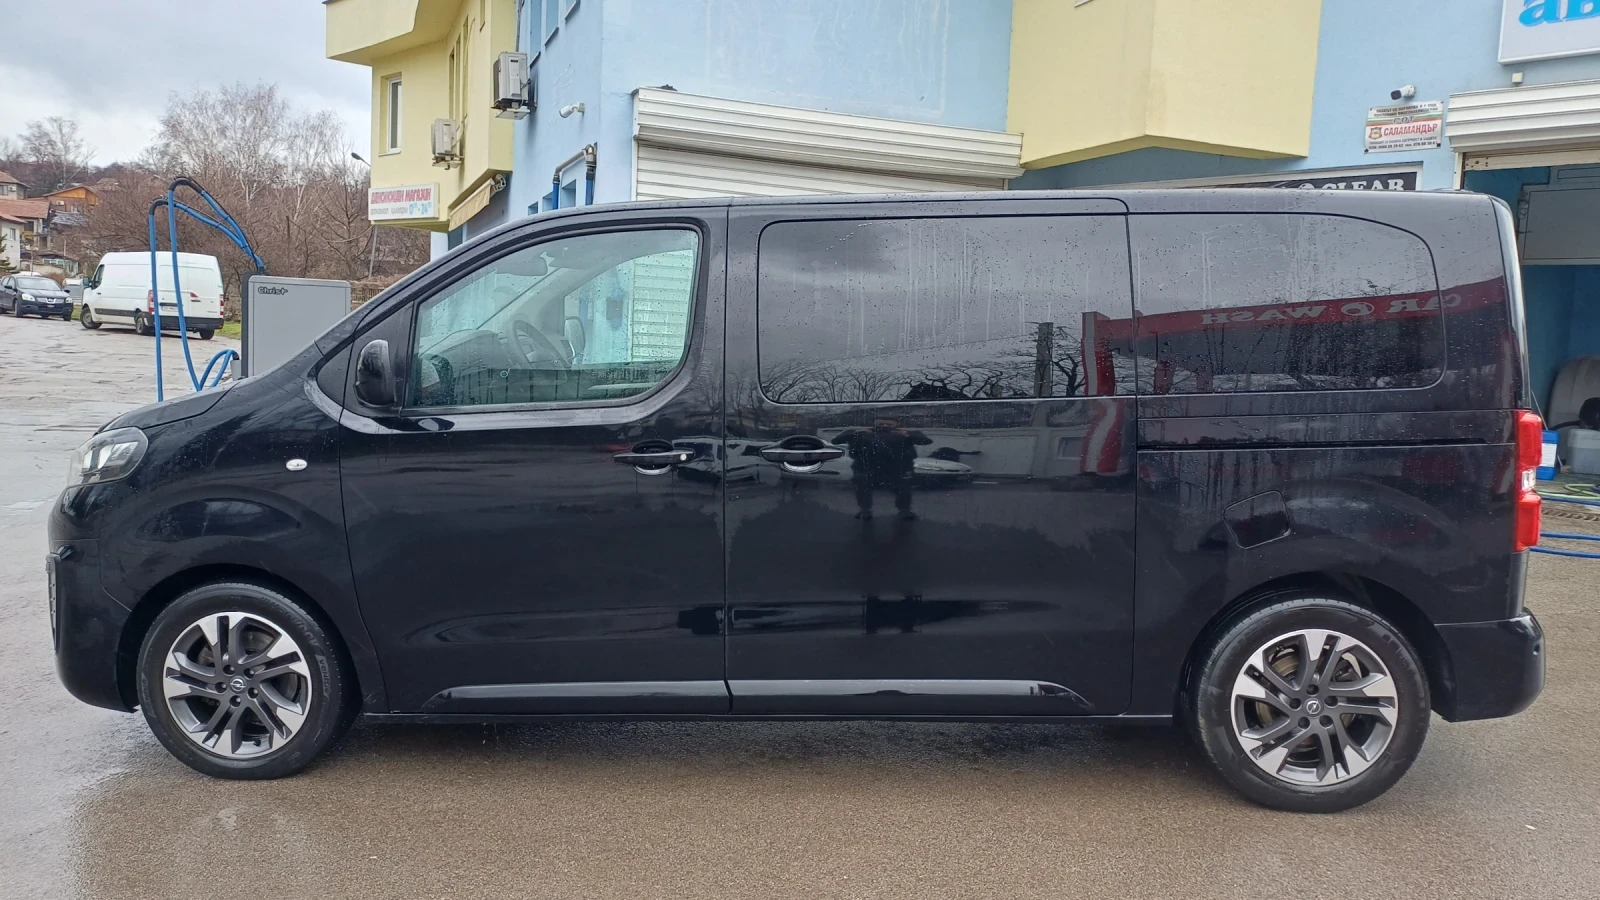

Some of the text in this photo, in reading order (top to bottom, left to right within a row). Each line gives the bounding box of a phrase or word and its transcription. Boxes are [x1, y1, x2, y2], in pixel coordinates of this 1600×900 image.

[1384, 124, 1438, 136] САЛАМАНДЪР
[405, 188, 431, 202] МАГАЗИН
[258, 286, 288, 295] Christ
